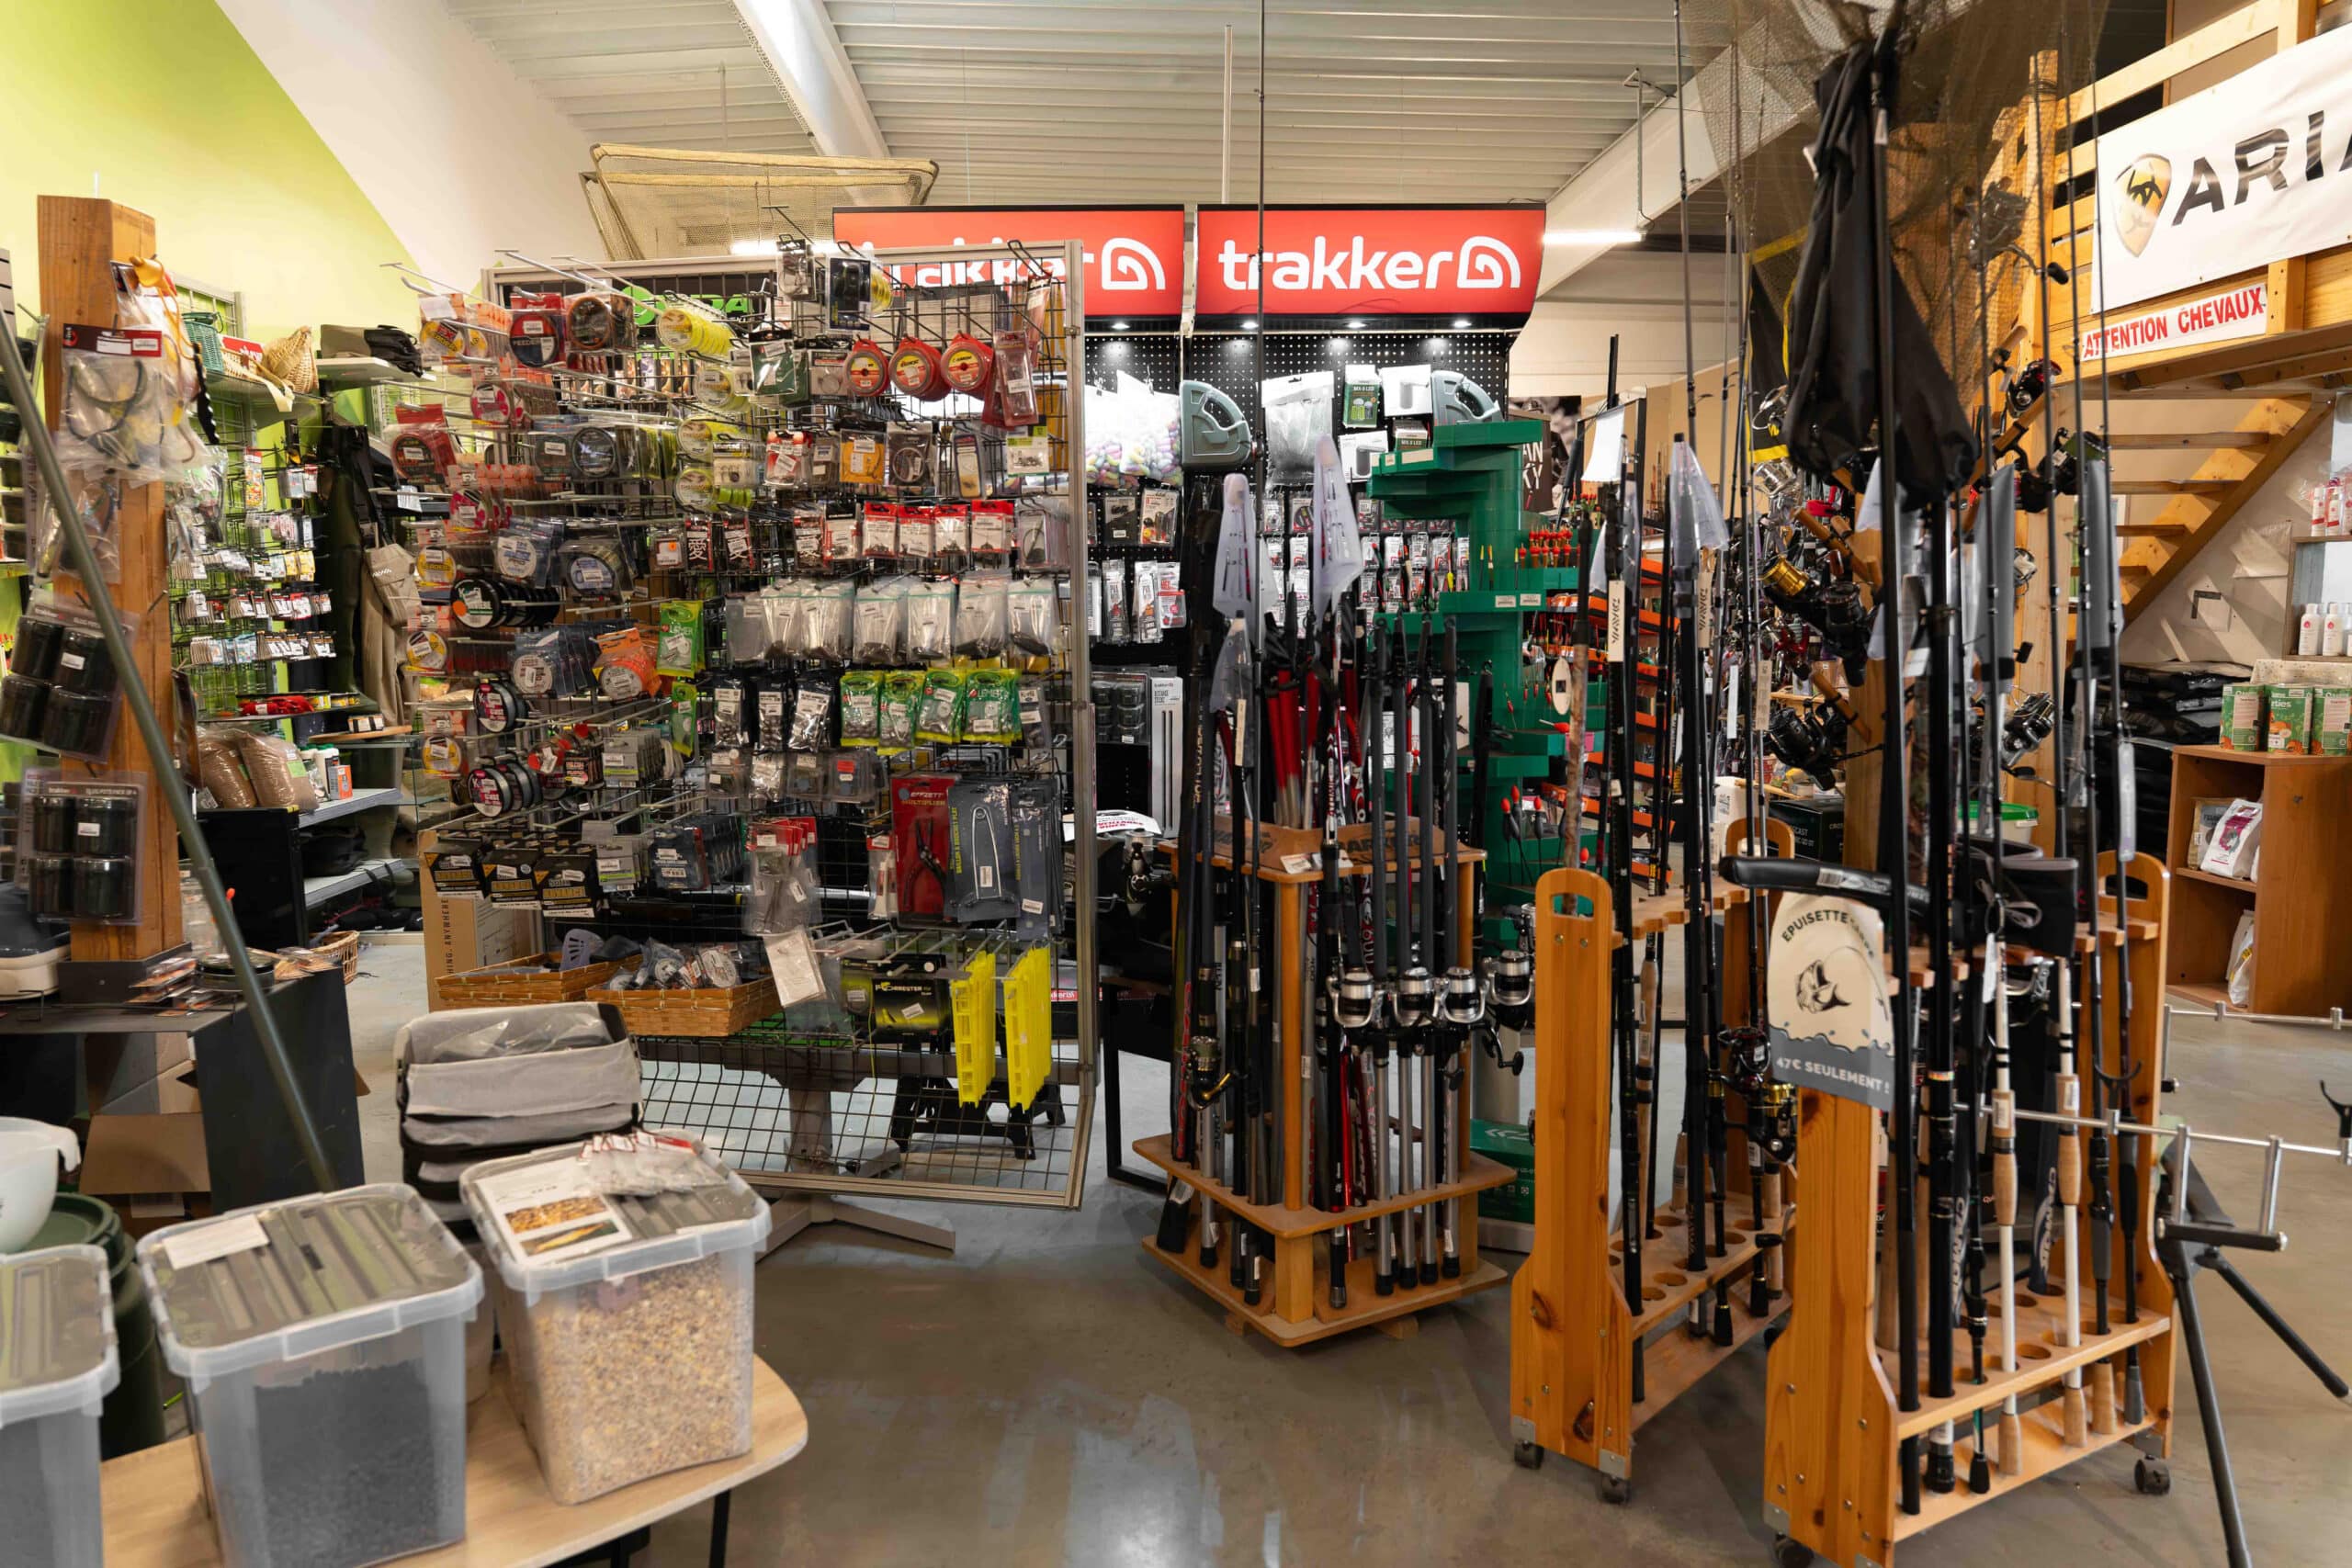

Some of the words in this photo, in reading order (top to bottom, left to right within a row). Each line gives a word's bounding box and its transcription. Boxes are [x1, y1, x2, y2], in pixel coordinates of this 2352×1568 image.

[2171, 109, 2352, 227] ARI
[1219, 235, 1453, 291] trakker
[2083, 313, 2168, 359] ATTENTION
[2177, 286, 2266, 333] CHEVAUX
[1781, 908, 1850, 943] EPUISETTE
[1804, 1061, 1882, 1093] SEULEMENT
